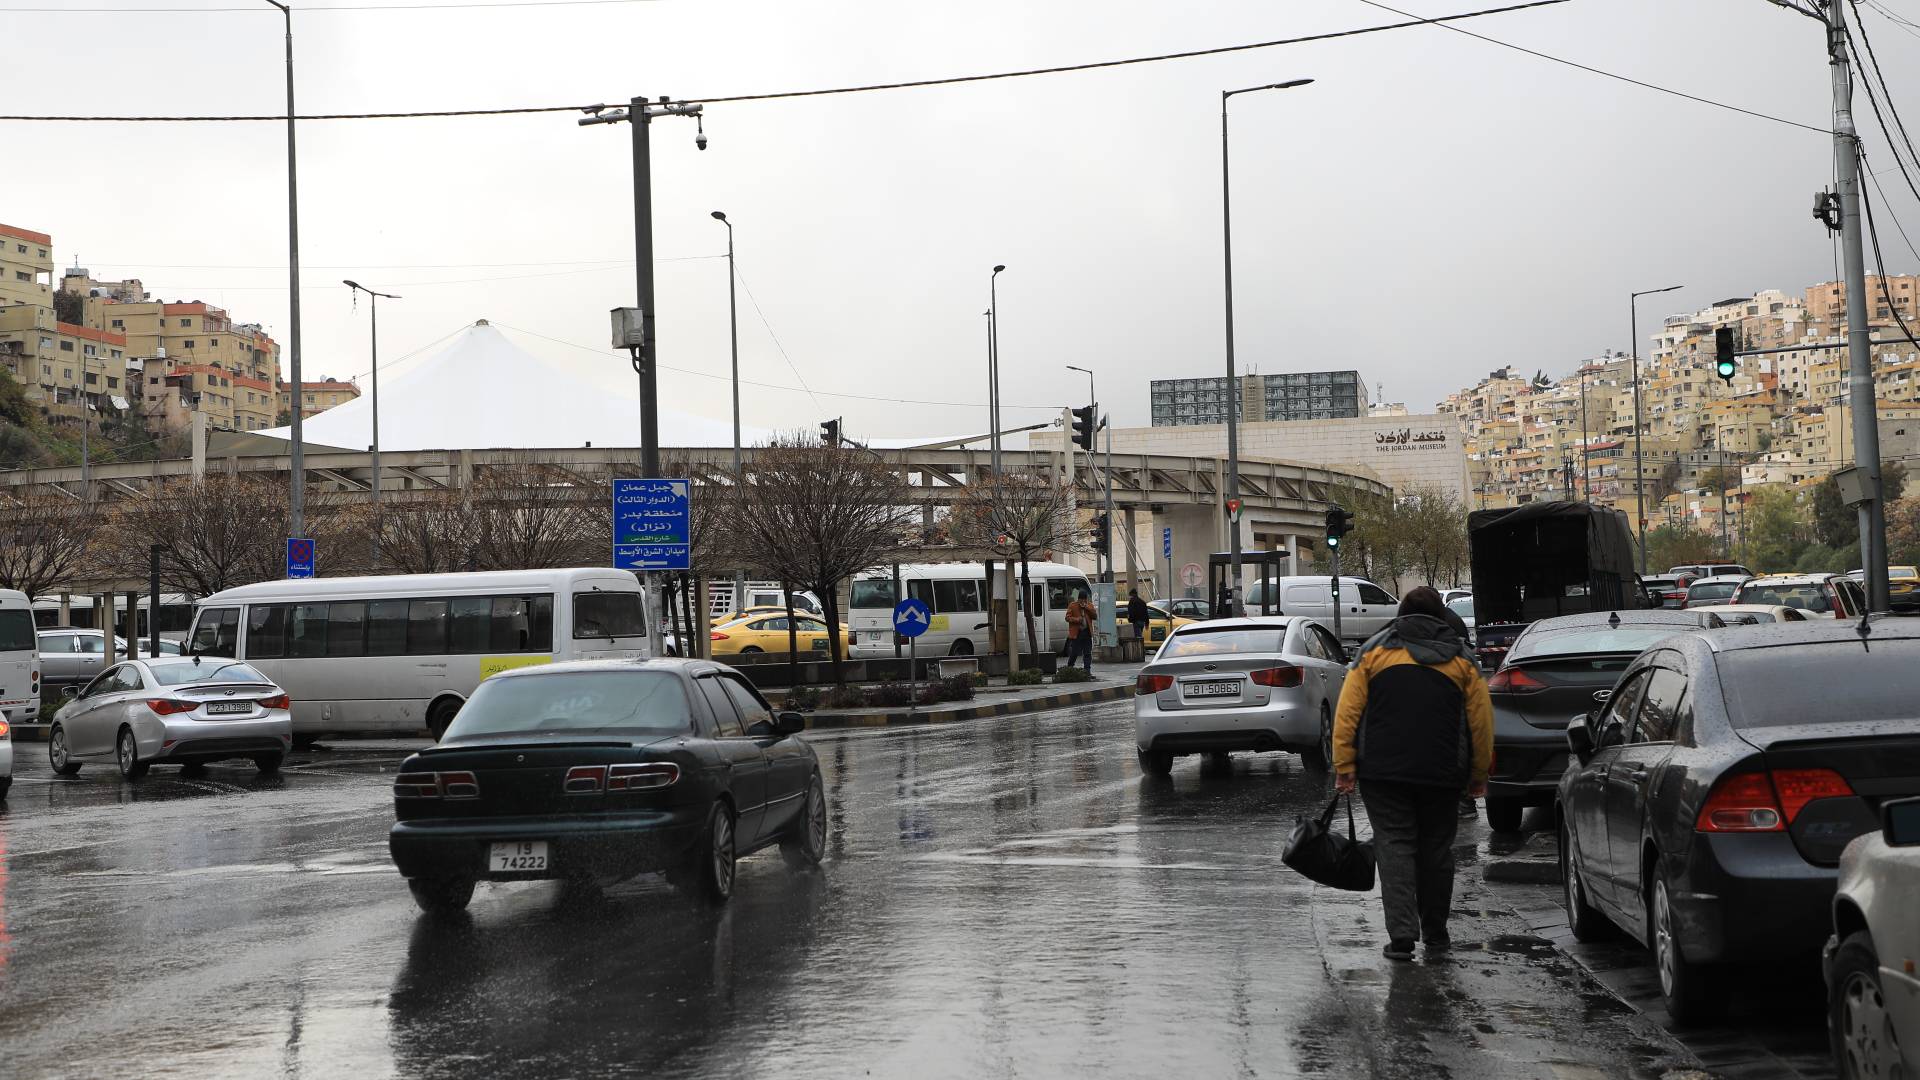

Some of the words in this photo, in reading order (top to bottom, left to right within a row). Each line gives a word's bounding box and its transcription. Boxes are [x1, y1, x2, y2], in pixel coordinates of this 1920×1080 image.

[1418, 443, 1447, 451] MUSEUM
[621, 484, 646, 492] عمان
[648, 484, 671, 492] جبل
[621, 511, 641, 519] بدر
[619, 546, 642, 557] الأوسط
[643, 546, 663, 557] الشرق
[665, 547, 685, 556] ميدان
[502, 857, 545, 869] 74222
